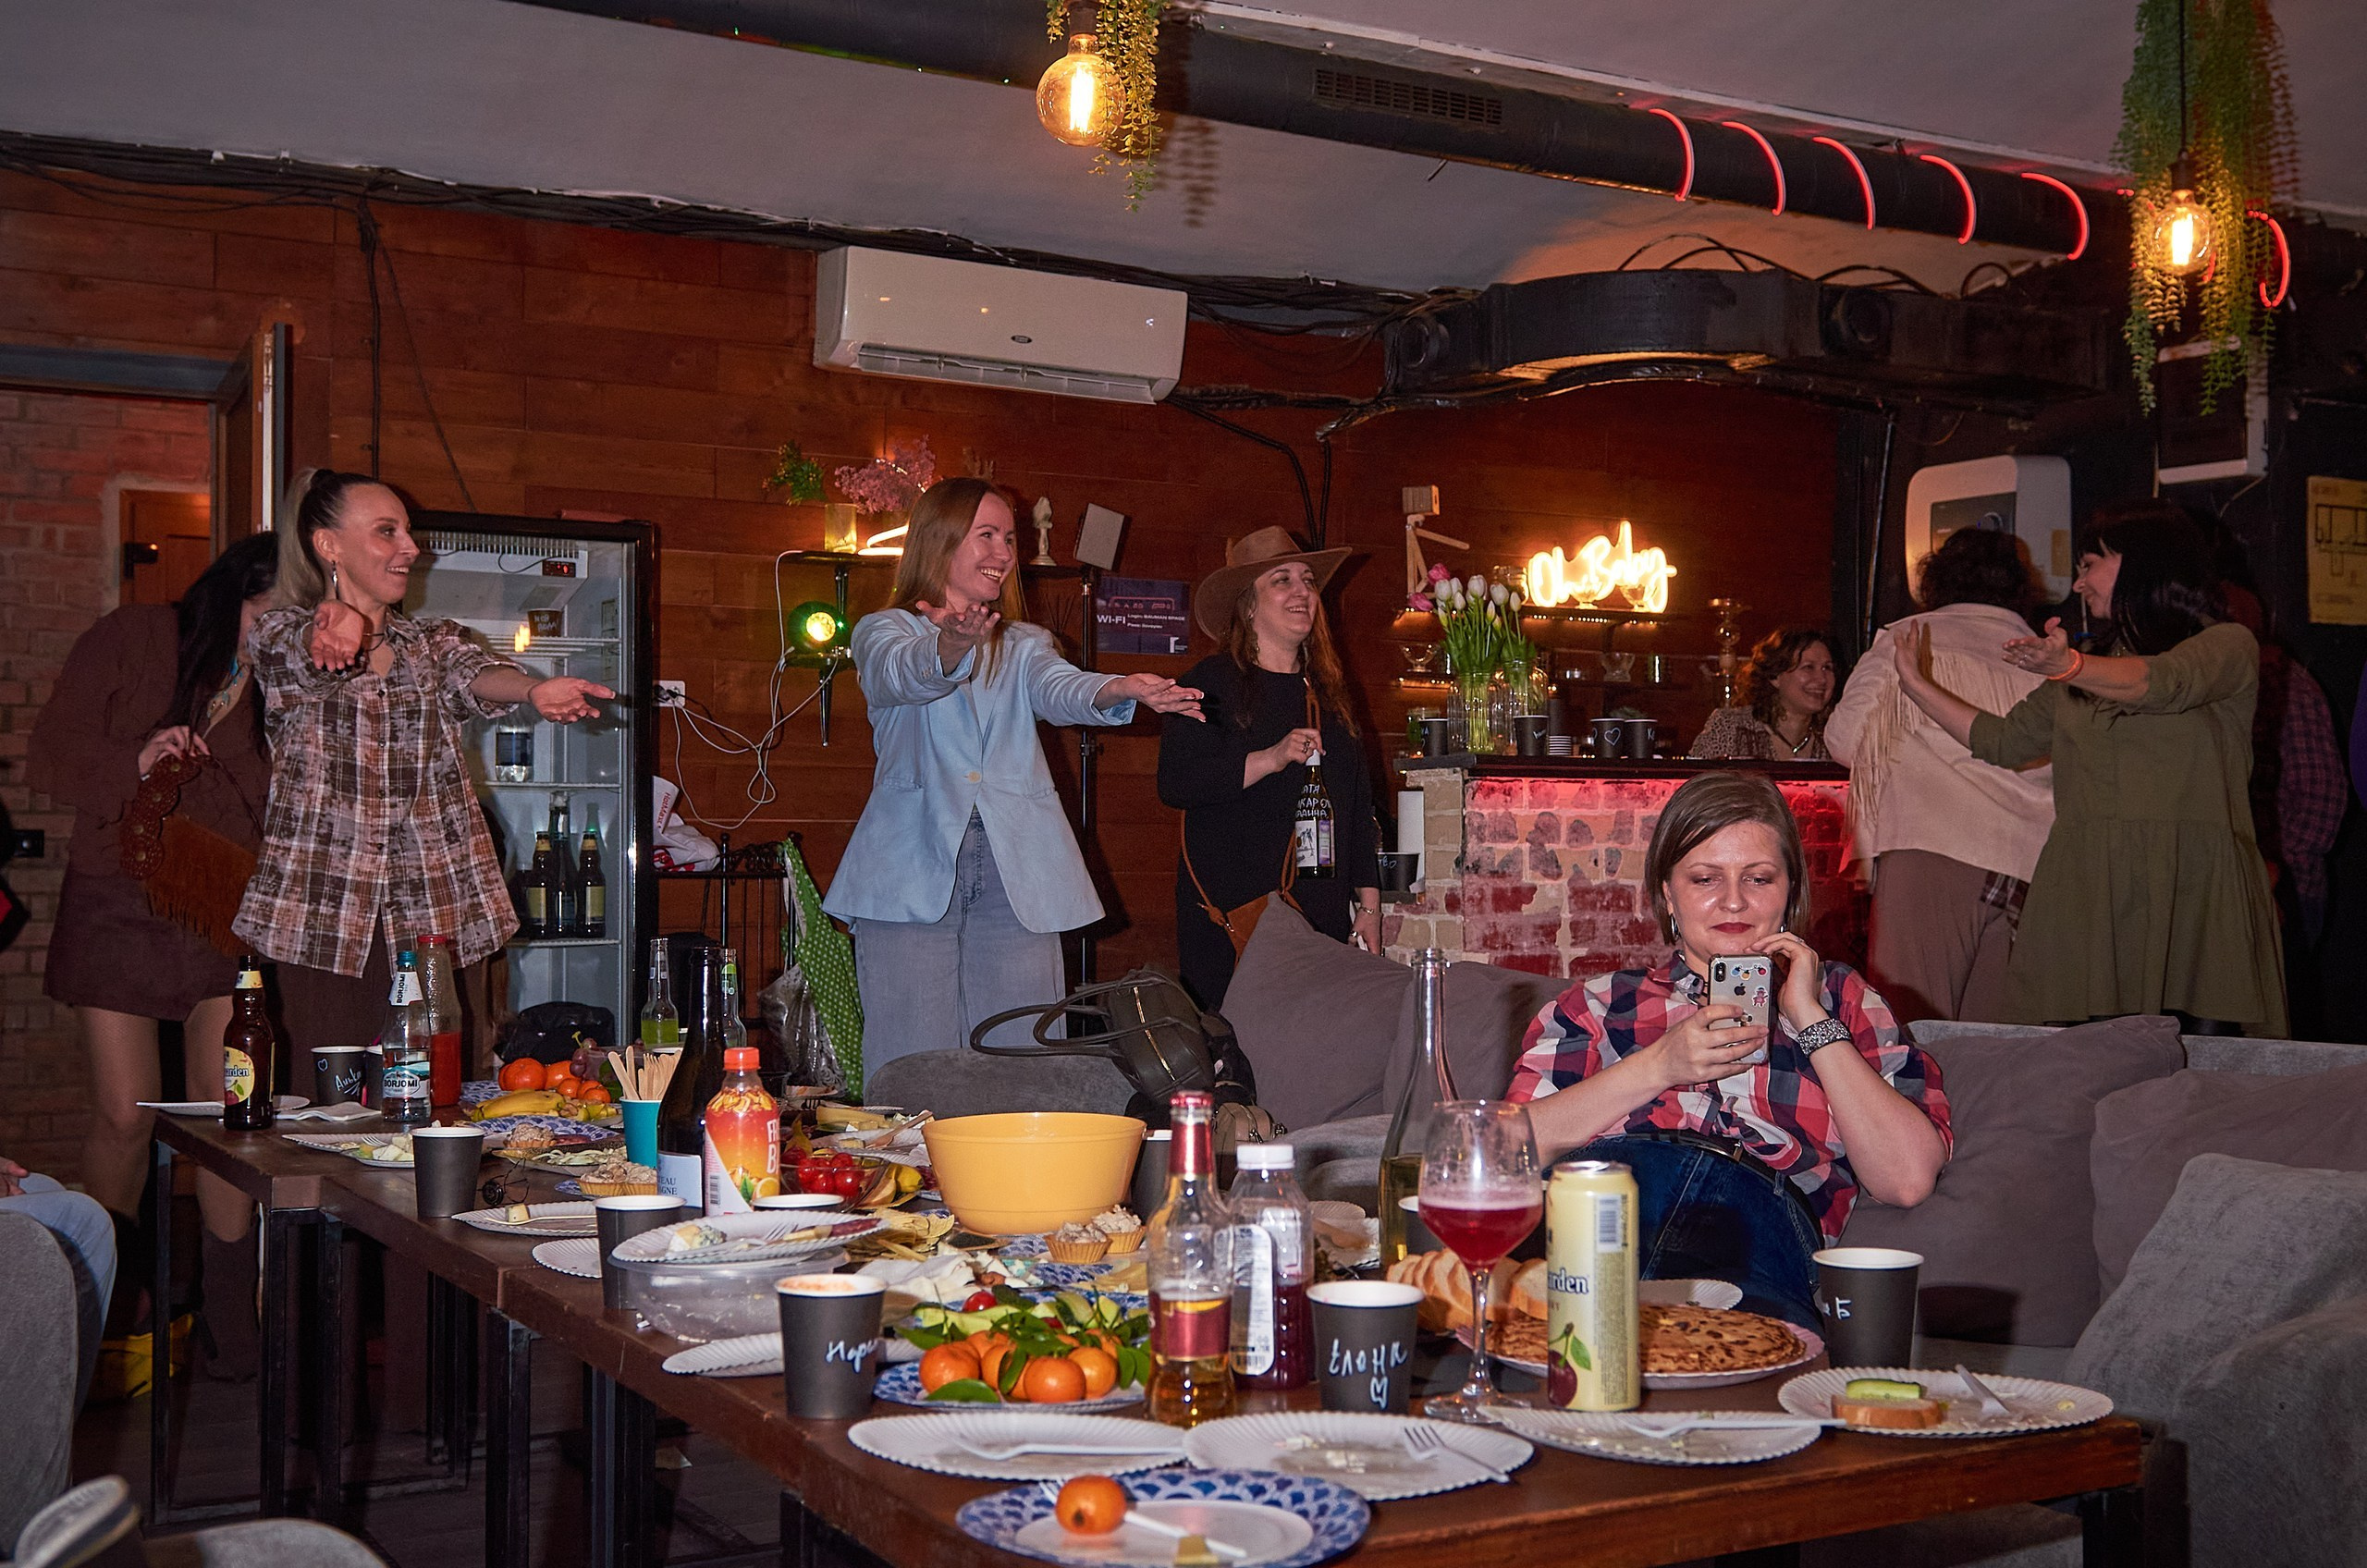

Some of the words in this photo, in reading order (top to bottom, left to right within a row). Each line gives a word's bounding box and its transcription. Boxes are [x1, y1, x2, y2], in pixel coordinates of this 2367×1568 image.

[1097, 614, 1126, 624] WI-FI
[397, 974, 406, 1004] BORJOMI
[384, 1079, 418, 1088] BORJOMI
